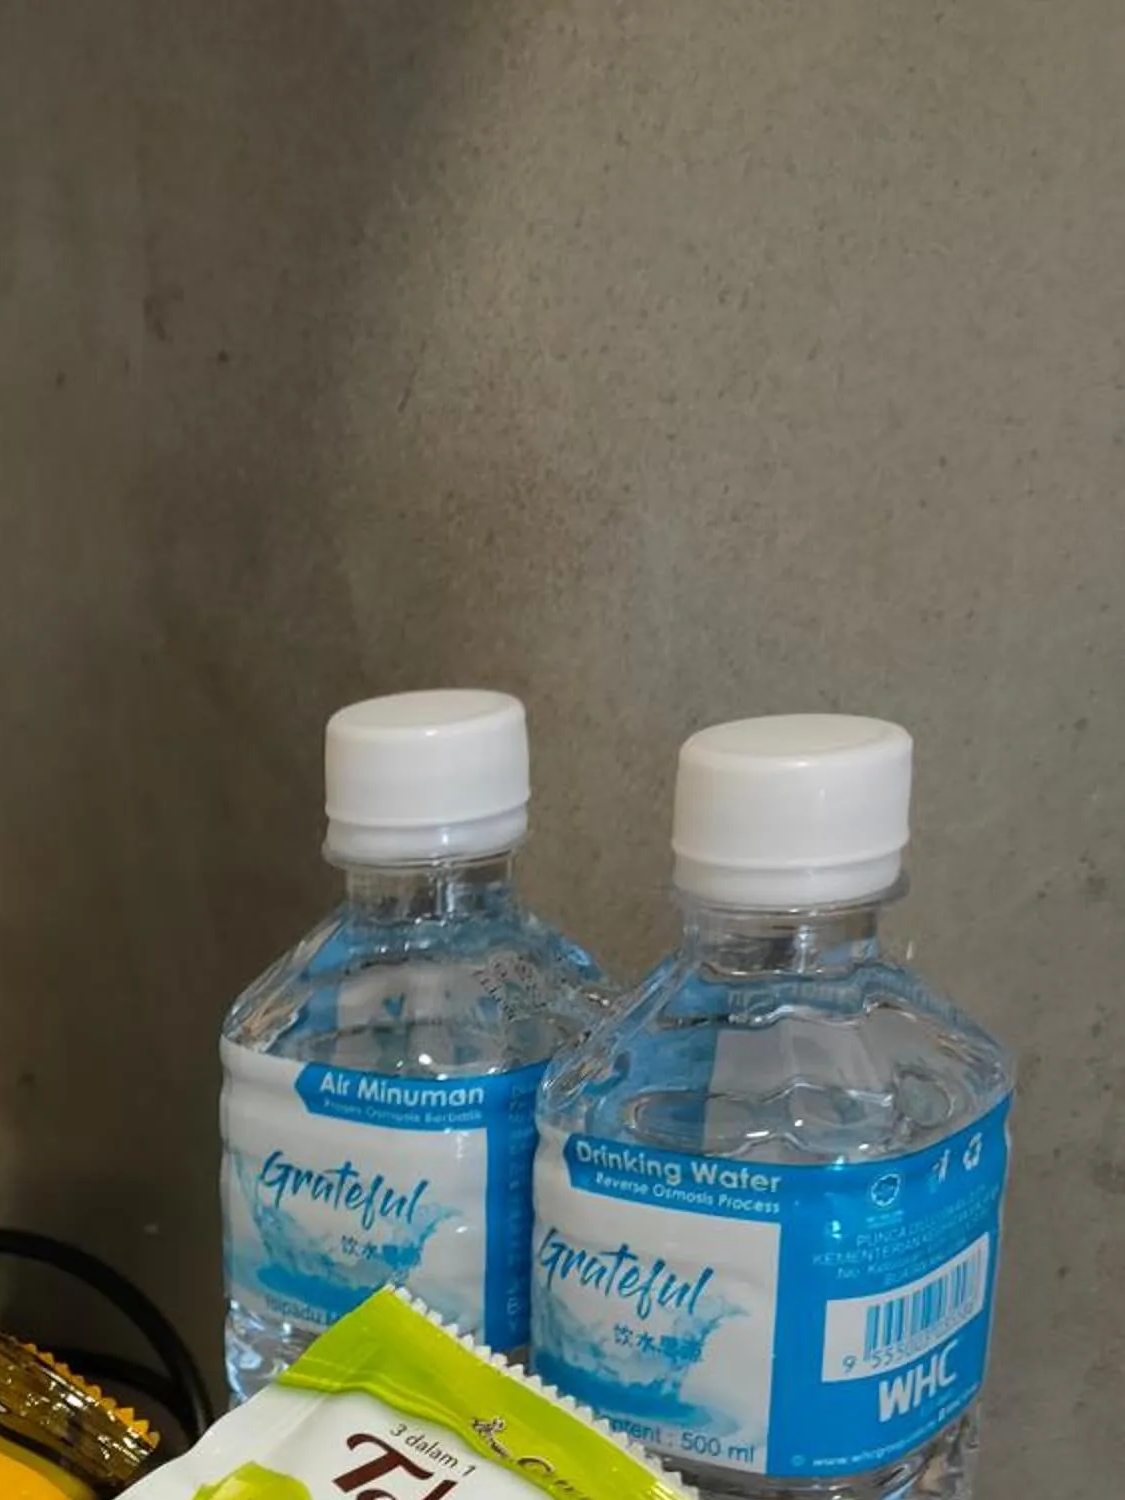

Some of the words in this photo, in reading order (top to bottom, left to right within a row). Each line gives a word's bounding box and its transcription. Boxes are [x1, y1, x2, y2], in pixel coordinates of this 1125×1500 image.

[319, 1071, 349, 1096] Air
[357, 1077, 485, 1106] Minuman
[258, 1150, 429, 1230] Grateful
[576, 1139, 682, 1186] Drinking
[690, 1161, 782, 1193] Water
[595, 1171, 649, 1195] Reverse
[652, 1183, 714, 1207] Osmosis
[718, 1193, 781, 1214] Process
[538, 1225, 714, 1320] Grateful
[878, 1338, 960, 1423] WHC
[389, 1422, 408, 1438] 3
[405, 1431, 459, 1470] dalam
[463, 1464, 476, 1478] 1
[680, 1431, 722, 1457] 500
[726, 1443, 755, 1464] ml
